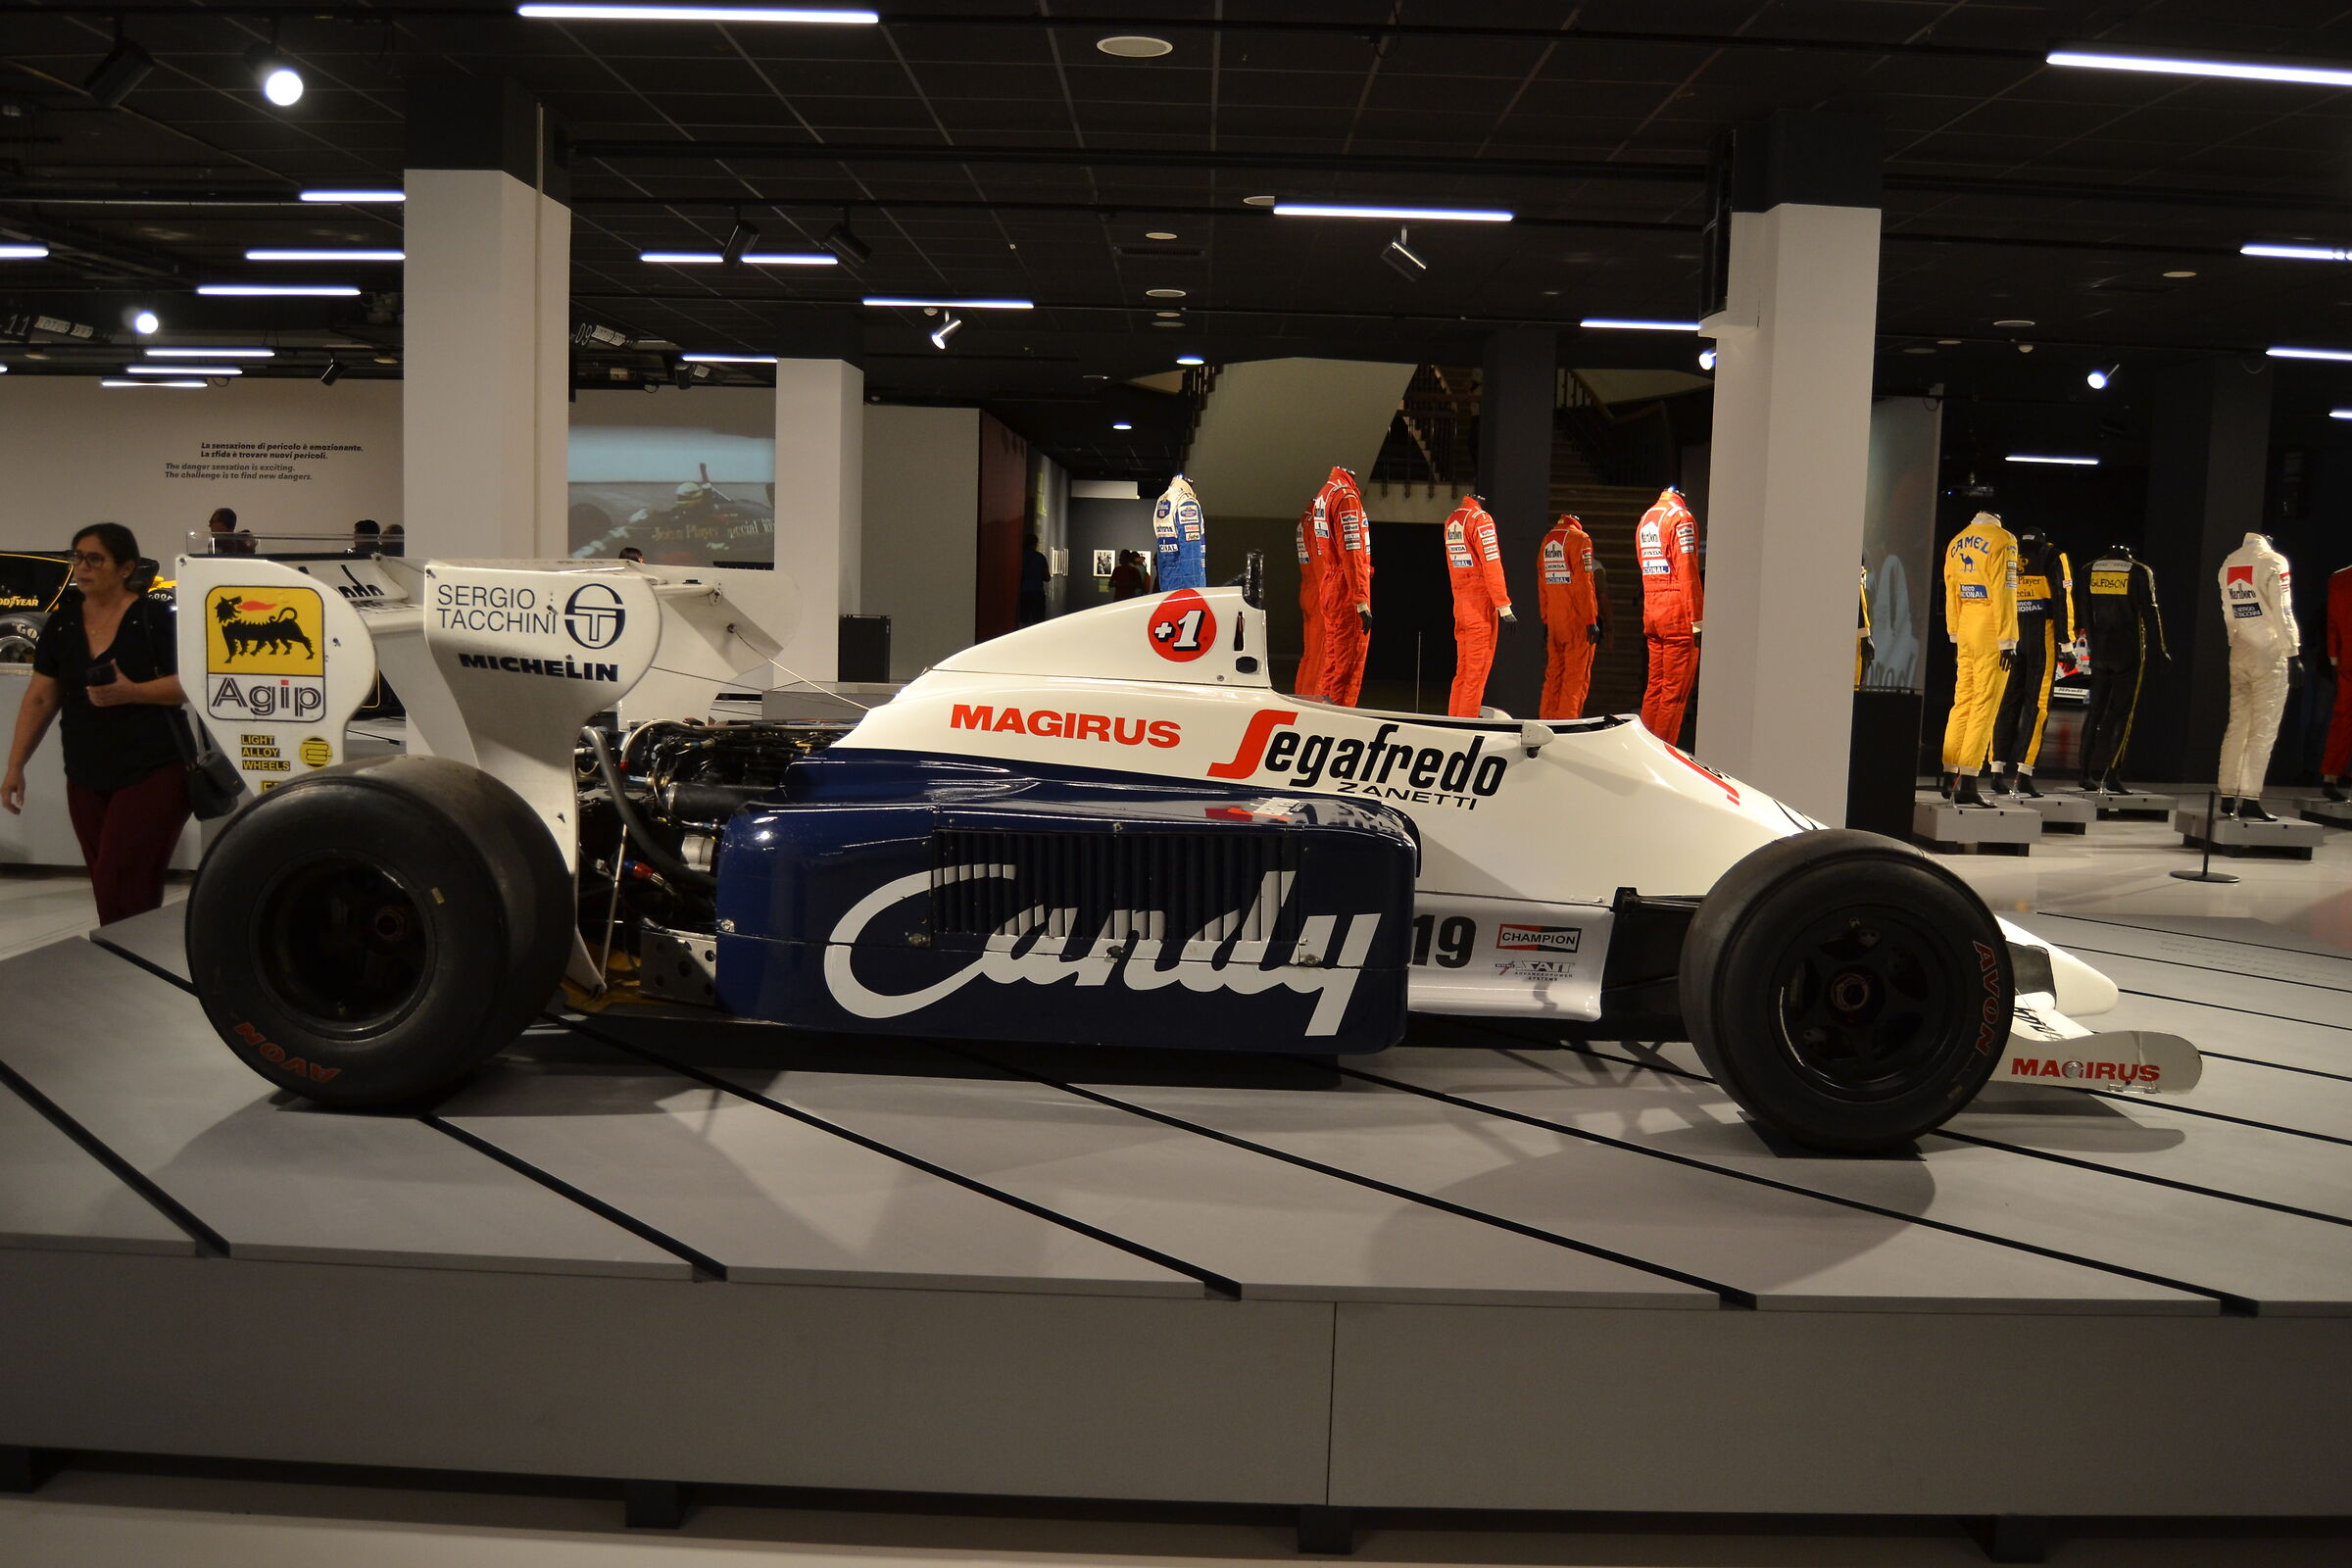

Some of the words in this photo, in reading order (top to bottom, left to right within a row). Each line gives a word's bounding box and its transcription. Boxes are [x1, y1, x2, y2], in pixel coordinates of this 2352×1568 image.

[181, 463, 211, 472] danger
[260, 464, 295, 473] exciting.
[294, 452, 328, 461] pericoli.
[180, 471, 220, 480] challenge
[1950, 535, 1990, 559] CAMEL
[2018, 576, 2041, 587] Player
[437, 584, 535, 610] SERGIO
[436, 608, 557, 634] TACCHINI
[458, 653, 618, 682] MICHELIN
[212, 677, 322, 717] Agip
[950, 704, 1182, 749] MAGIRUS
[241, 735, 274, 745] LIGHT
[242, 748, 280, 758] ALLOY
[242, 760, 290, 771] WHEELS
[1206, 709, 1509, 798] Segafredo
[1336, 781, 1478, 811] ZANETTI
[824, 863, 1382, 1037] Candy
[1412, 913, 1477, 969] 19
[1501, 931, 1576, 947] CHAMPION
[1973, 940, 2001, 1057] AVON
[233, 1021, 342, 1083] AVON
